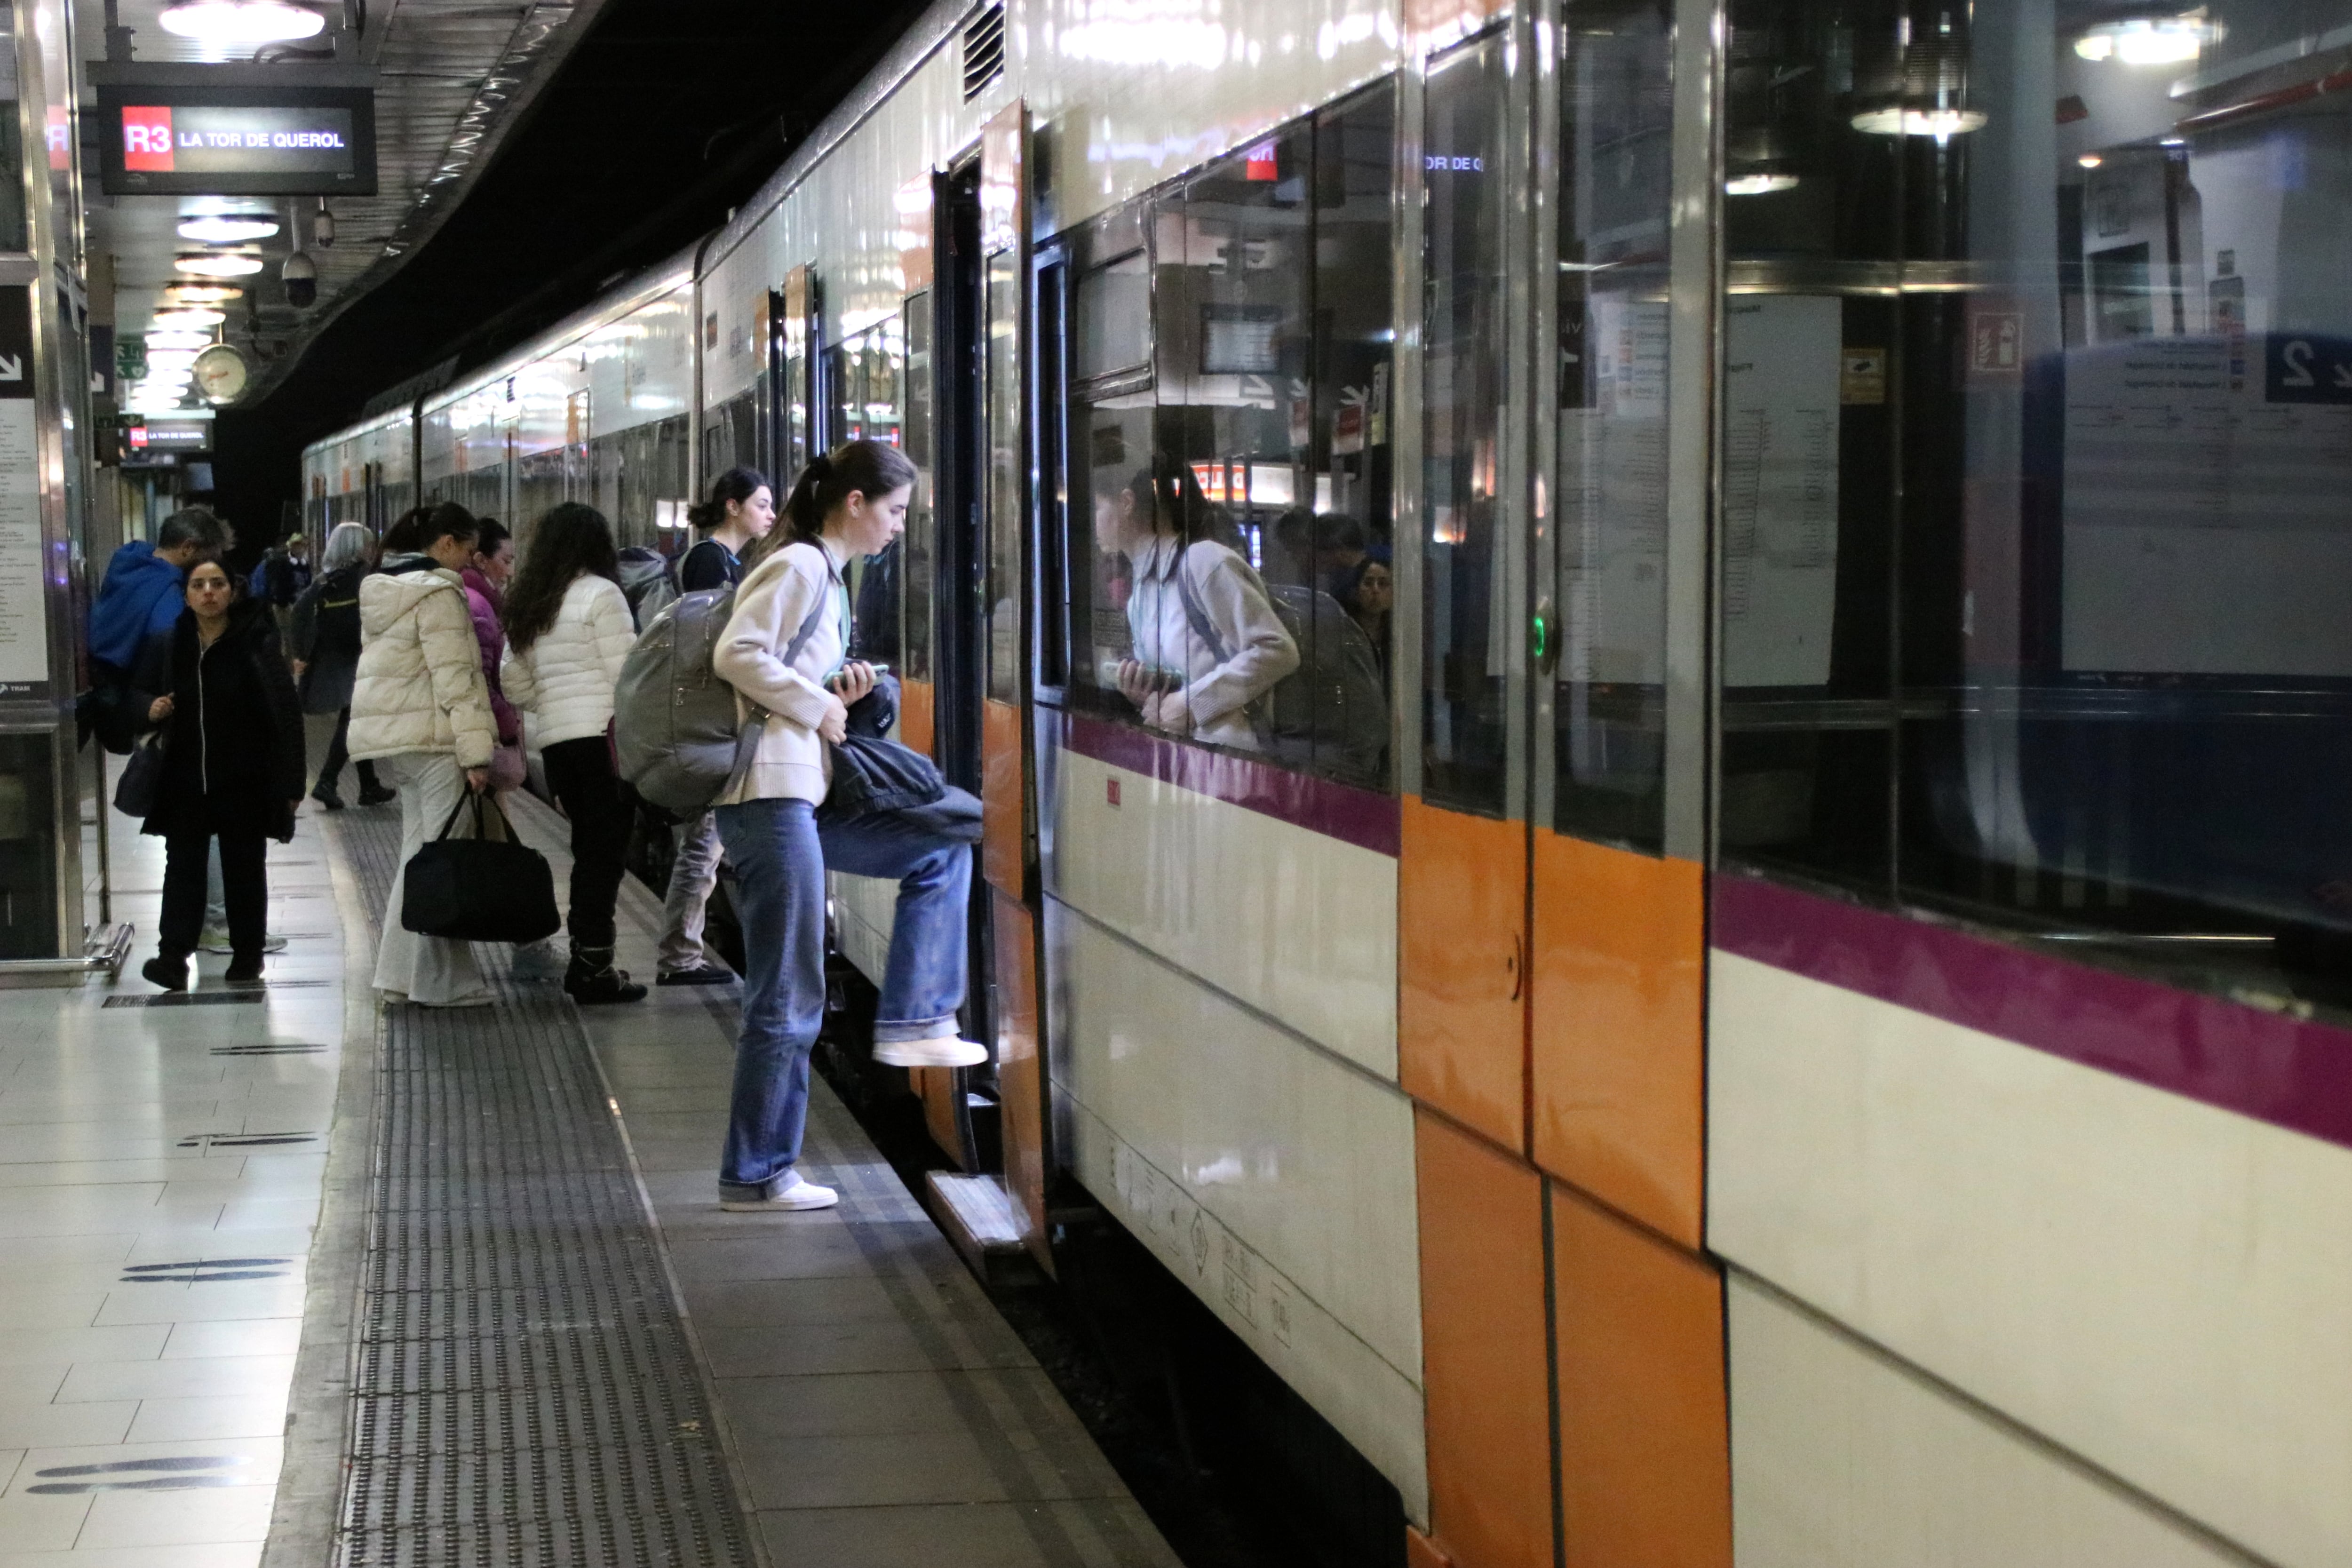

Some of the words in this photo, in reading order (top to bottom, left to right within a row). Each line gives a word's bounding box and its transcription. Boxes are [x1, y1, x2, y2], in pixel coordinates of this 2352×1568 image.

[126, 126, 171, 152] R3
[181, 133, 203, 147] LA
[207, 133, 241, 147] TOR
[246, 133, 270, 147] DE
[274, 133, 344, 148] QUEROL
[1425, 157, 1447, 170] OR
[1453, 157, 1470, 170] DE
[131, 431, 147, 441] R3
